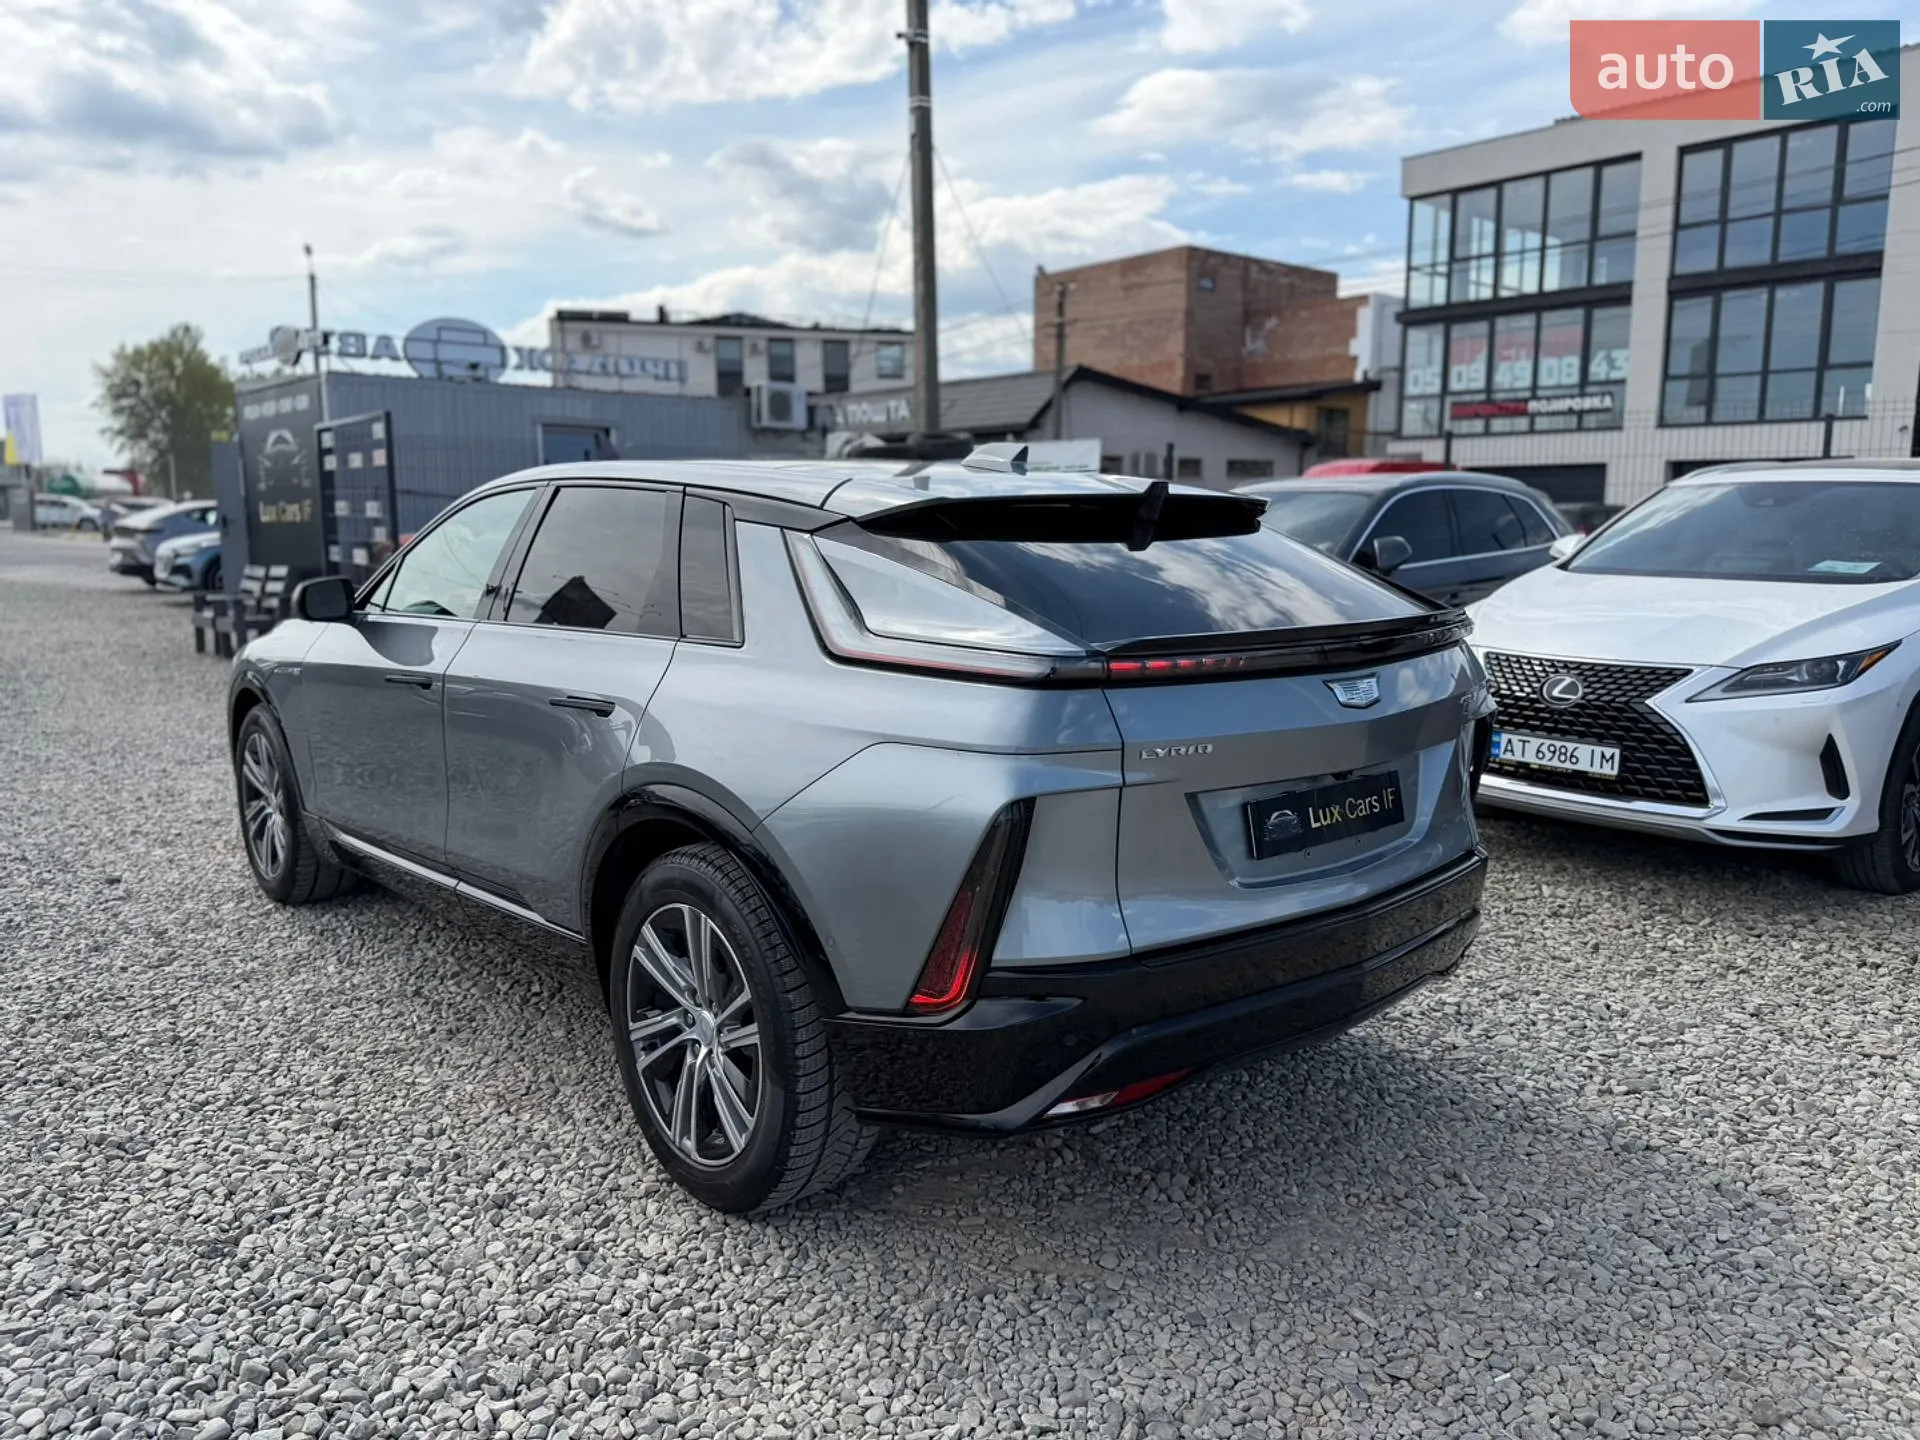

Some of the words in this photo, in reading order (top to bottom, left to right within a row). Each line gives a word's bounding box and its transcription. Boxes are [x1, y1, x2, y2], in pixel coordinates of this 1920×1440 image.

[1140, 743, 1213, 760] LYRIQ
[1502, 738, 1531, 758] AT
[1535, 742, 1579, 765] 6986
[1590, 748, 1615, 771] IM
[1307, 804, 1342, 829] Lux
[1345, 794, 1380, 818] Cars
[1383, 787, 1396, 810] IF
